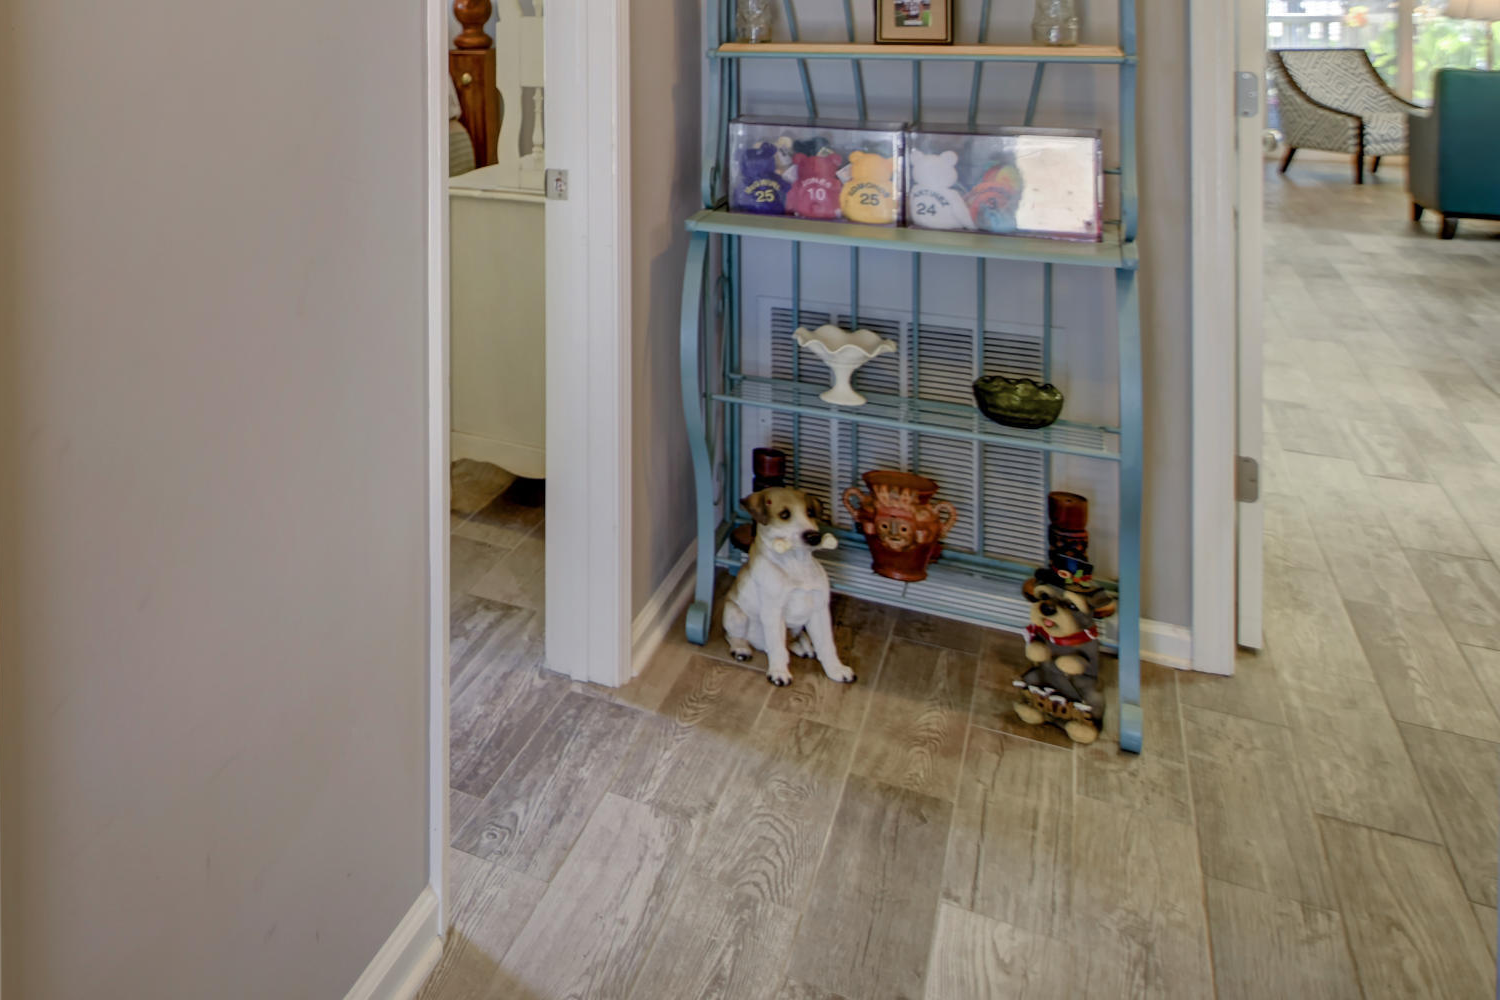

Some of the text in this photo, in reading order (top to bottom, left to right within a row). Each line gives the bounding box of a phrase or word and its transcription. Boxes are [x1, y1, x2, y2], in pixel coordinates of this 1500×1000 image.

[755, 189, 775, 203] 25
[807, 188, 827, 201] 10
[860, 193, 880, 206] 25
[916, 203, 937, 216] 24
